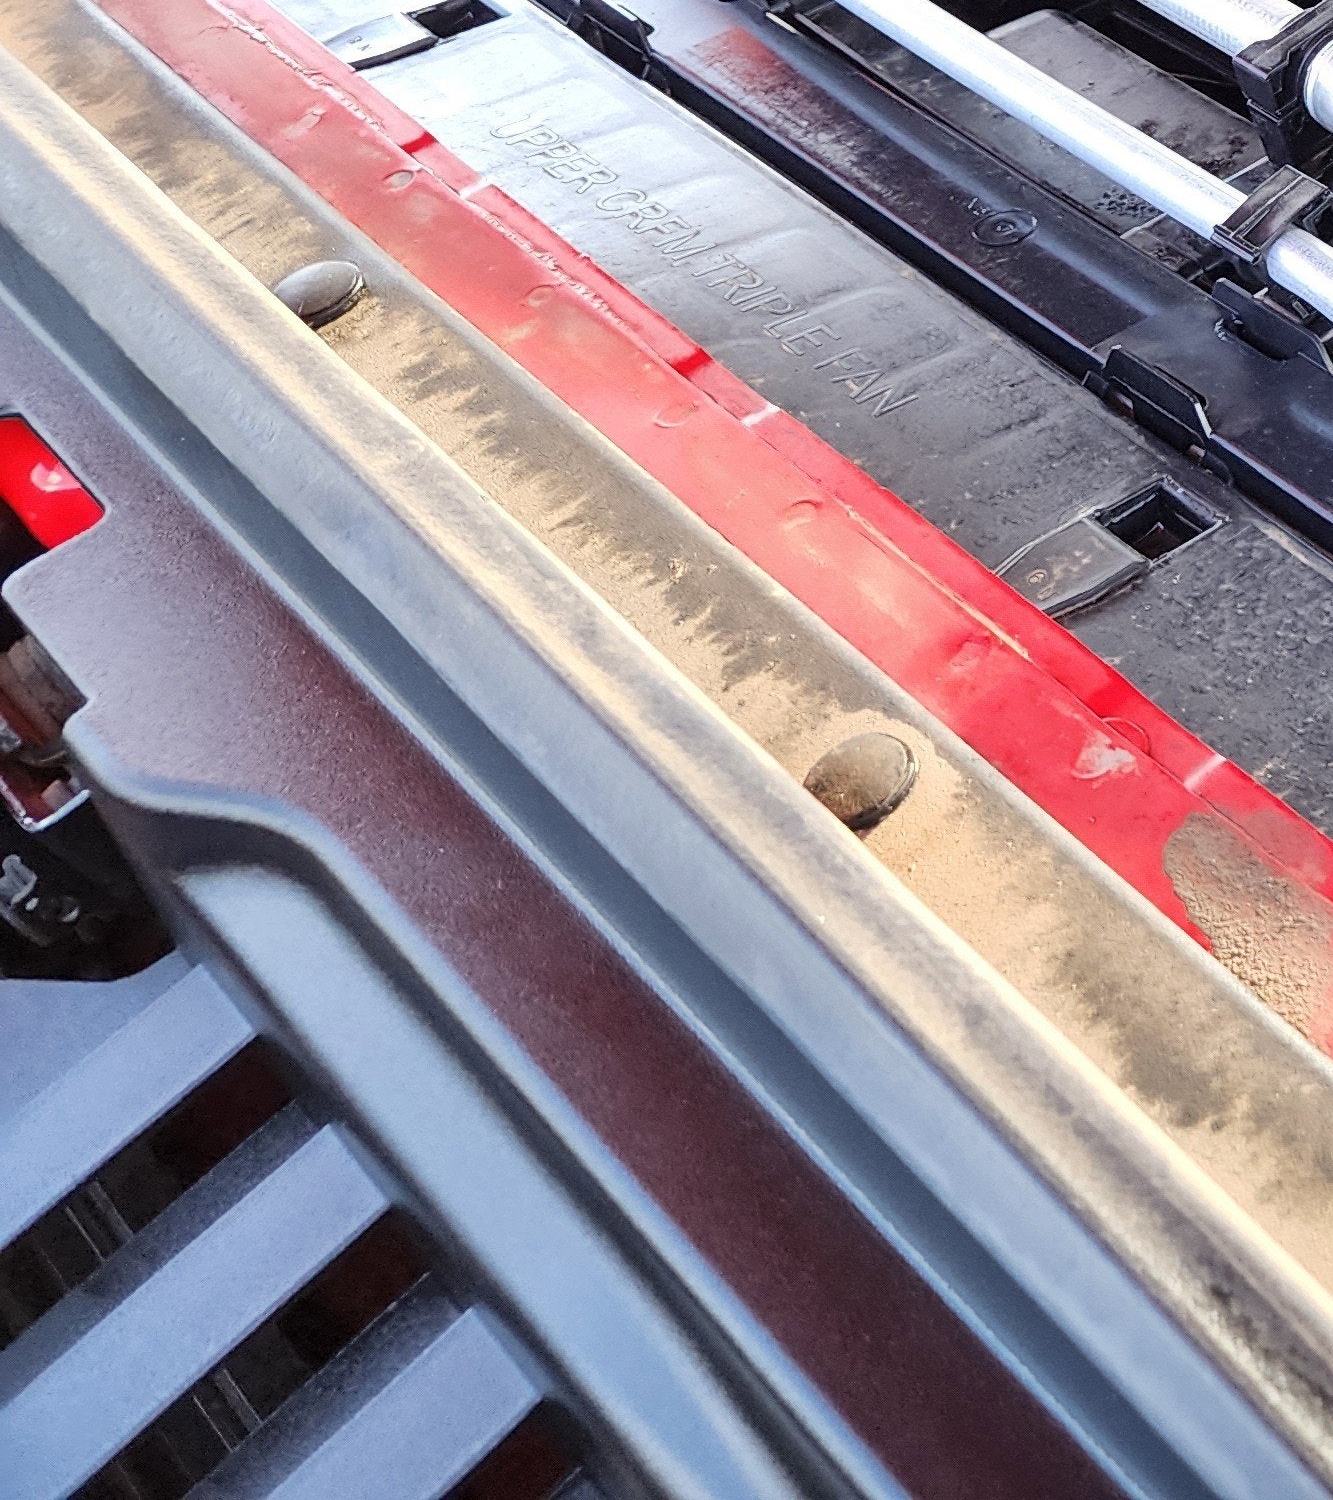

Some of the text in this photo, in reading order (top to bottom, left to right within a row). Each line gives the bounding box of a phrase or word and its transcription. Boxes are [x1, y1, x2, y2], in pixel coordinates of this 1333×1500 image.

[489, 111, 919, 419] UPPER CRFM TRIPLE FAN
